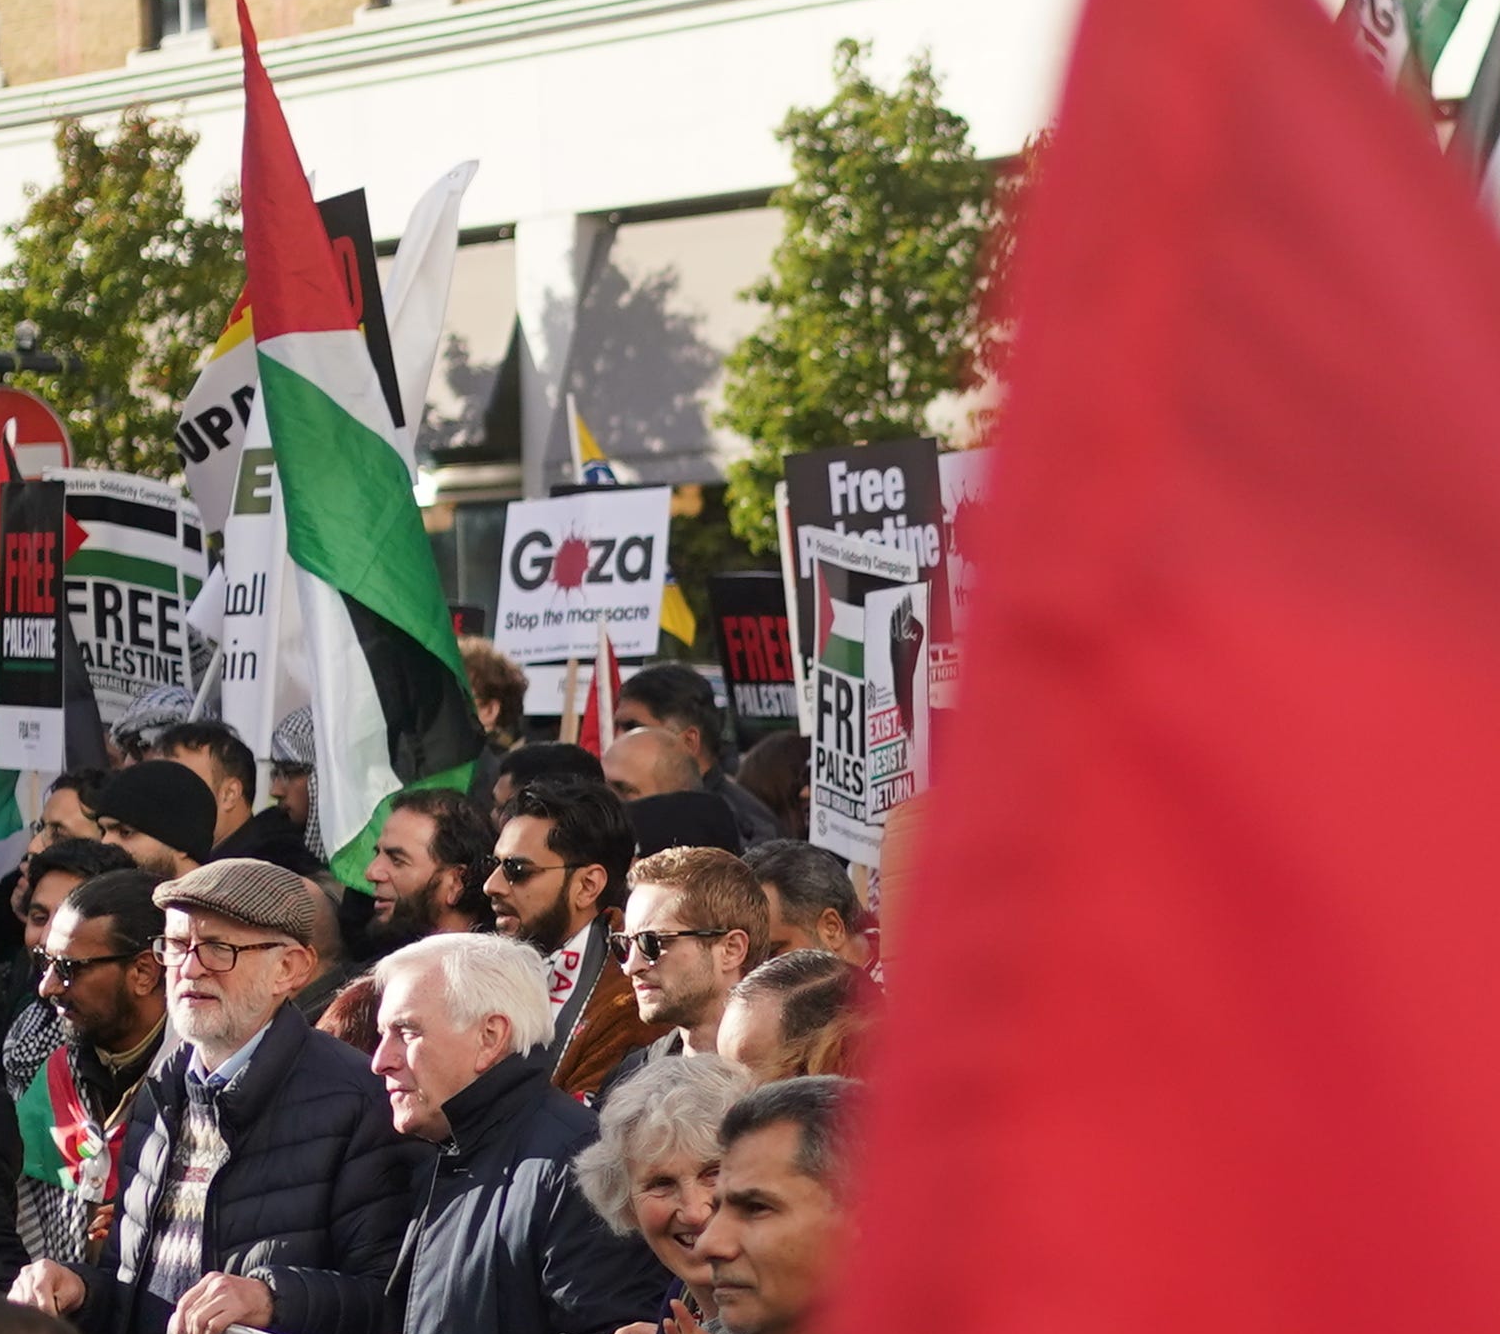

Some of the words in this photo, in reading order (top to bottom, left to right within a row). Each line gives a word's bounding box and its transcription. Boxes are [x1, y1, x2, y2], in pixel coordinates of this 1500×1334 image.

[828, 460, 906, 516] Free
[5, 531, 57, 614] FREE
[510, 529, 654, 592] Gza
[2, 617, 57, 659] PALESTINE
[504, 610, 540, 632] Stop
[542, 607, 564, 627] the
[566, 604, 650, 624] massacre
